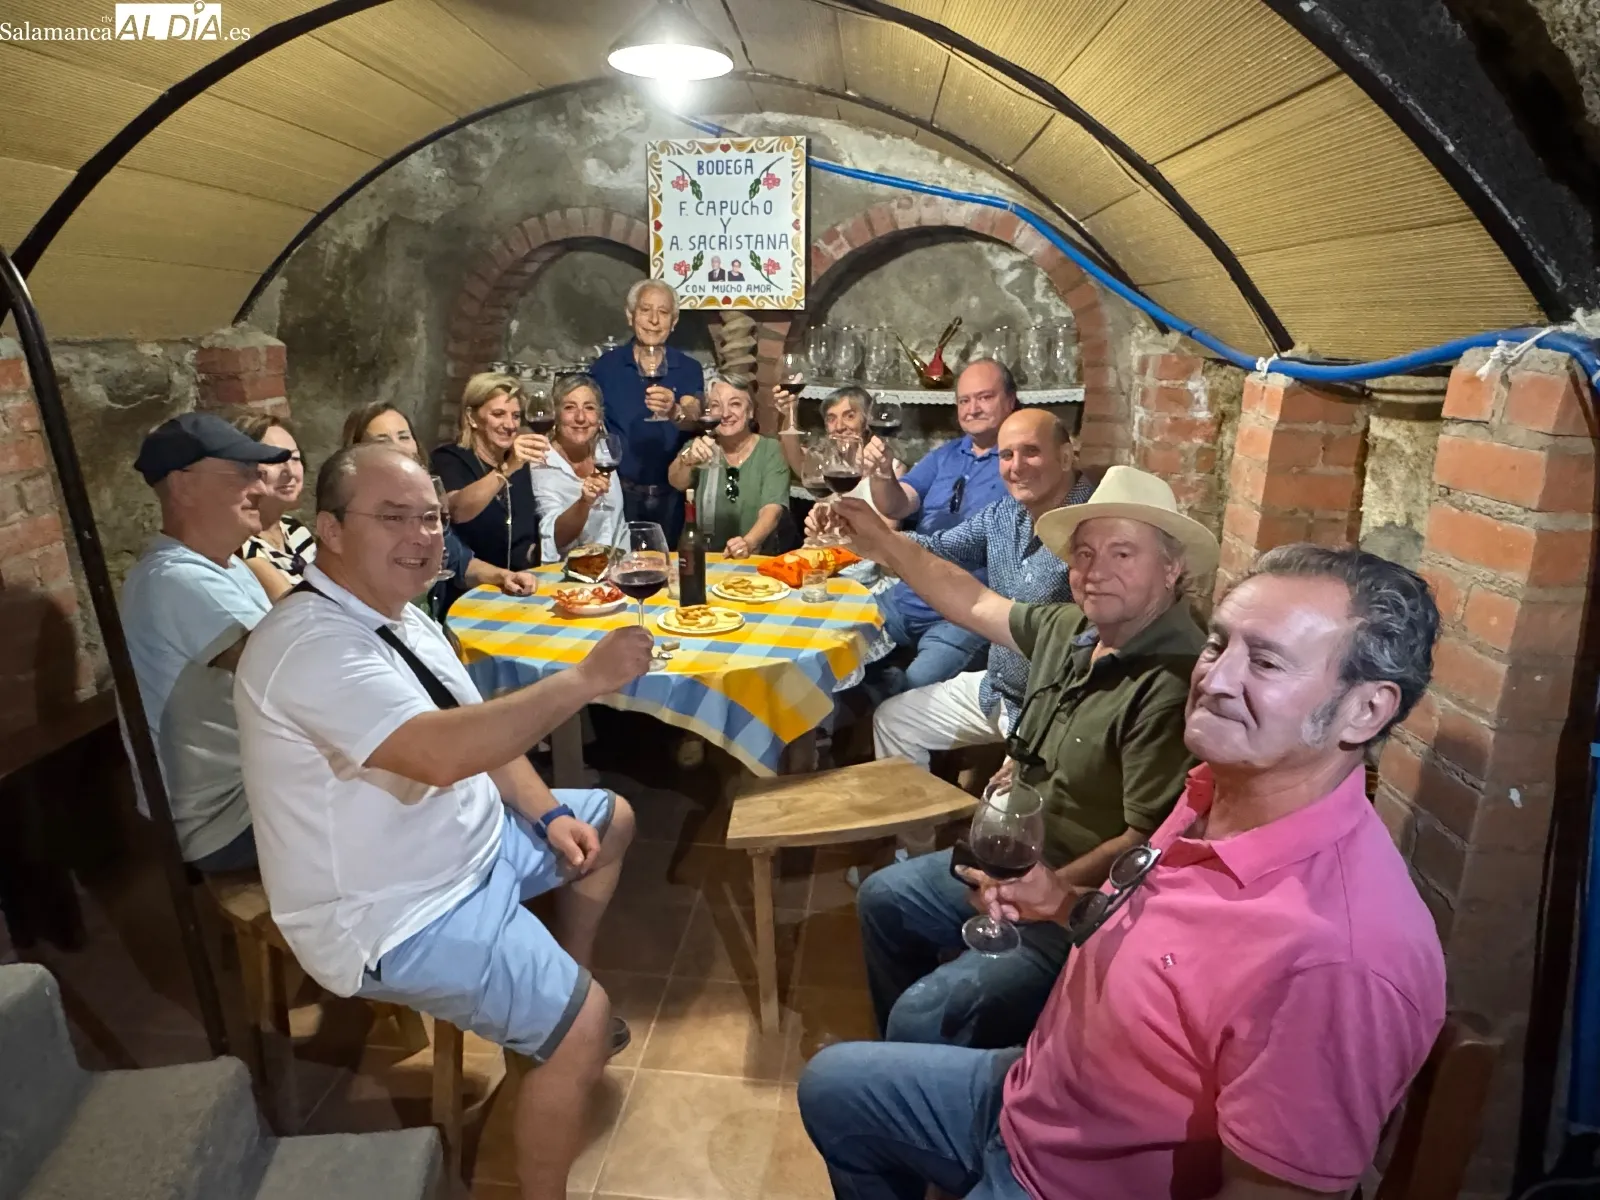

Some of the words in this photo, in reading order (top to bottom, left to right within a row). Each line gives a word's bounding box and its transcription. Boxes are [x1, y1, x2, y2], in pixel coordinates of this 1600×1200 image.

[697, 159, 754, 176] BODEGA
[679, 201, 689, 217] F.
[720, 217, 732, 234] Y
[669, 236, 683, 251] A.
[688, 233, 789, 251] SACRISTANA
[685, 284, 706, 293] CON
[746, 284, 772, 293] AMOR
